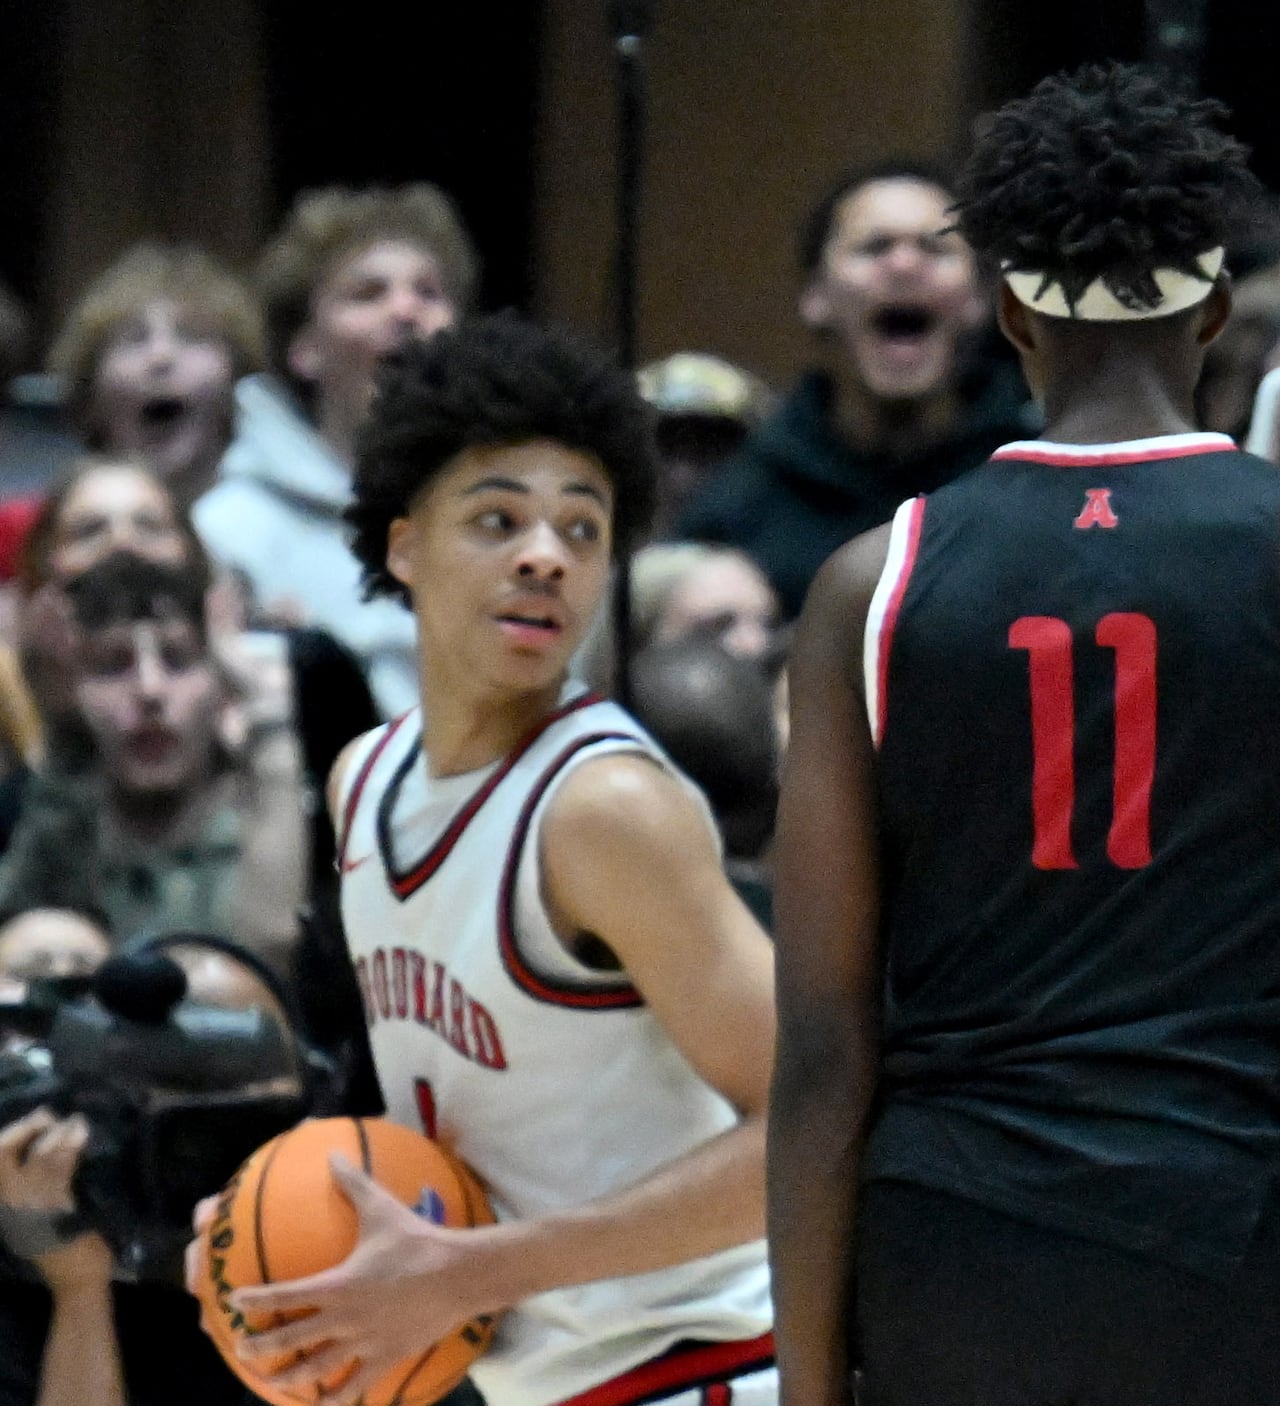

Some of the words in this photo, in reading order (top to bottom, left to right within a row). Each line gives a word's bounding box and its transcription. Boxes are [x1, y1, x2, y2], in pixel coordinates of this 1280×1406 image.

[1073, 487, 1119, 529] A
[1008, 612, 1158, 870] 11
[355, 946, 509, 1071] OODWARD
